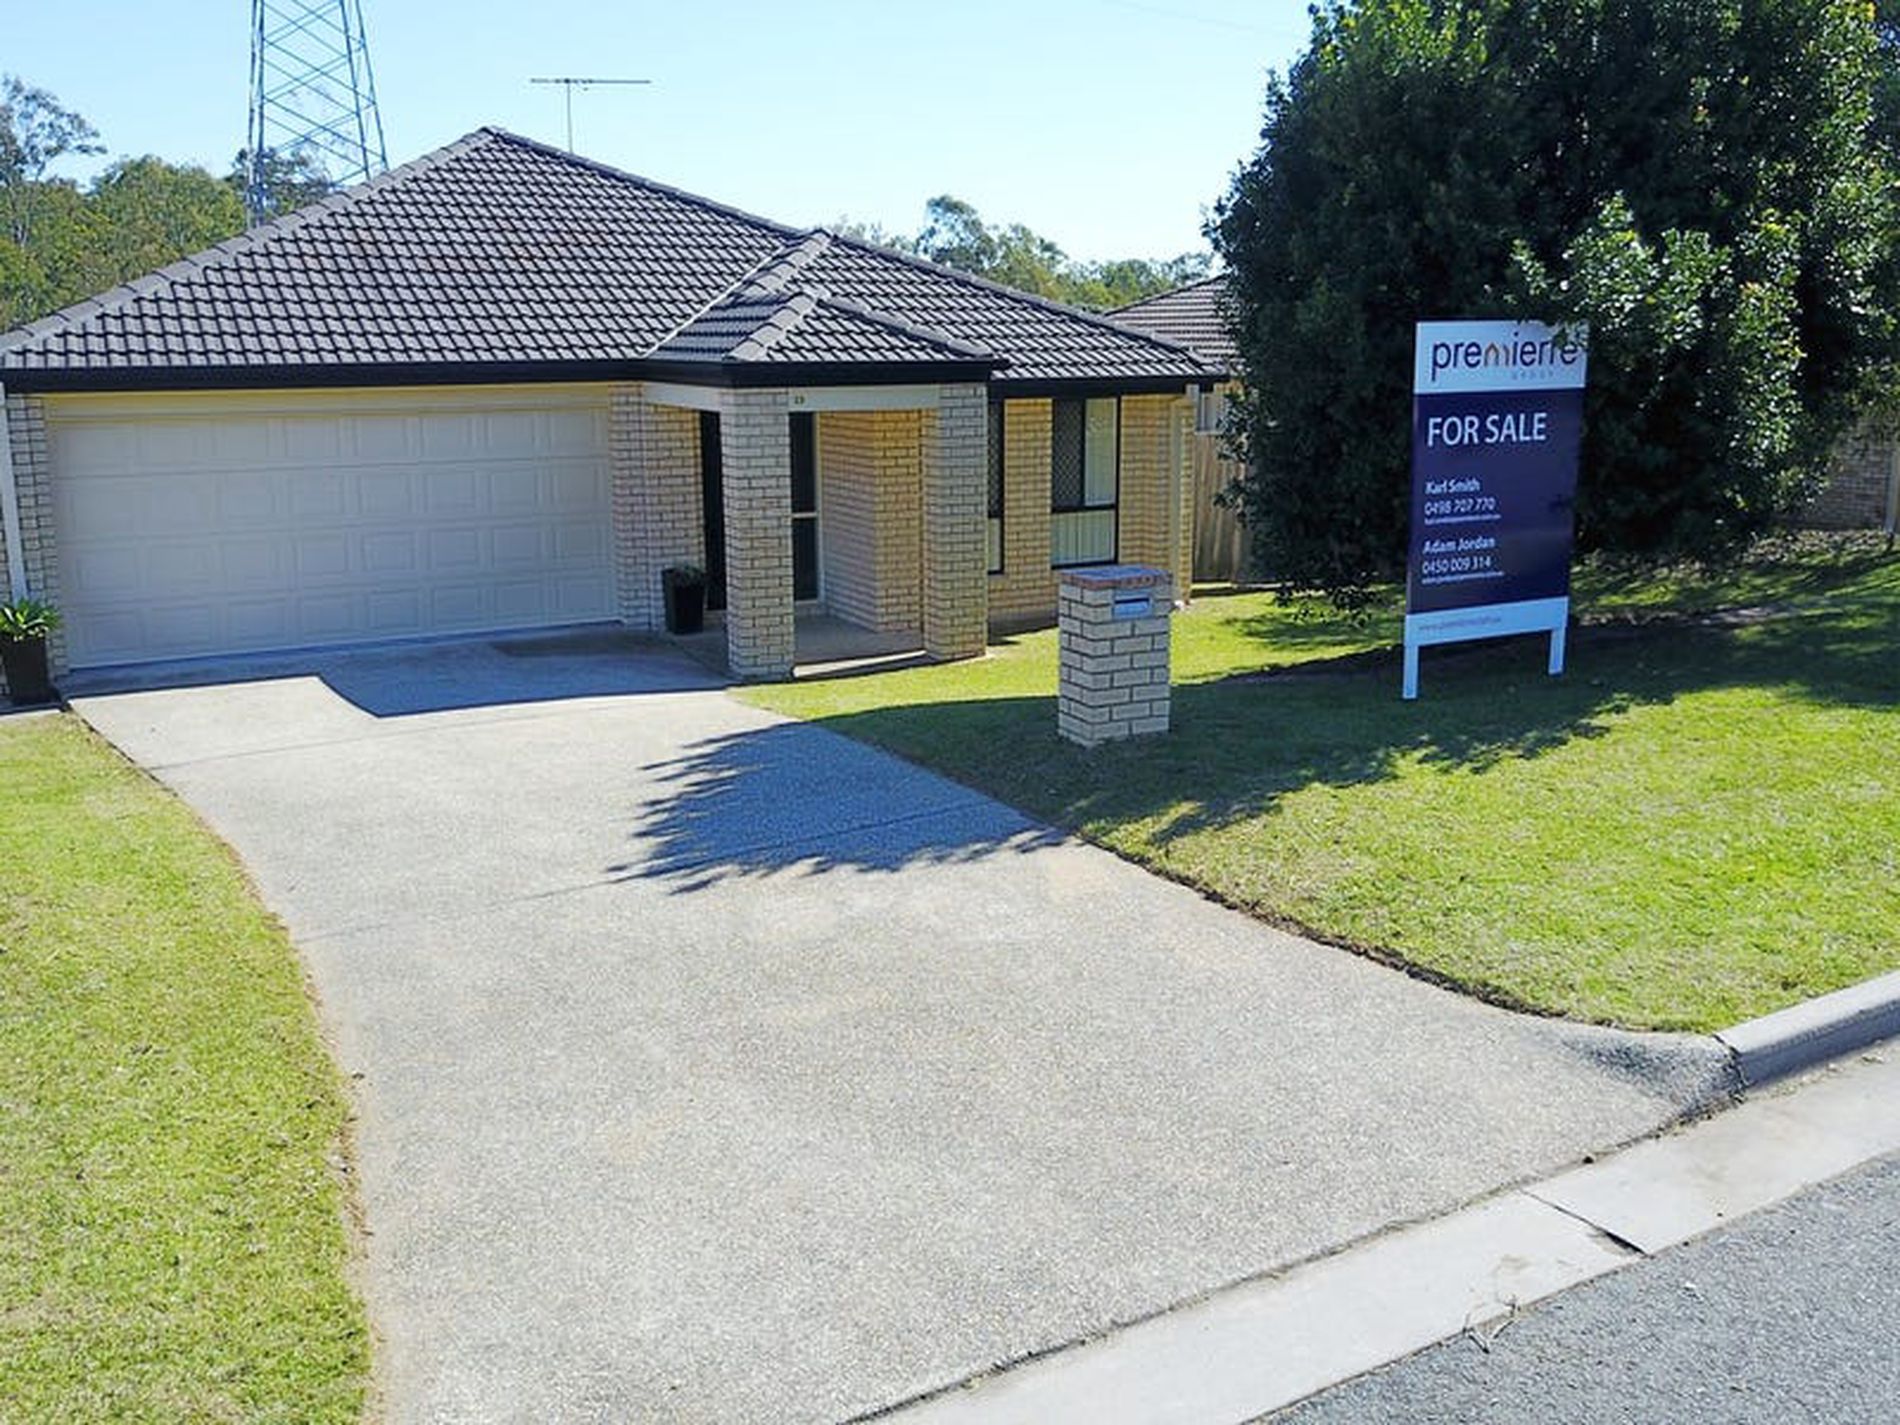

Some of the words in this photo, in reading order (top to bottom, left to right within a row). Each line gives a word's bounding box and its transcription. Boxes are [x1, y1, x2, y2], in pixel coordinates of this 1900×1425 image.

[1427, 417, 1479, 447] FOR
[1485, 413, 1547, 442] SALE
[1449, 478, 1480, 493] Smith
[1422, 540, 1456, 554] Adam
[1458, 536, 1495, 551] Jordan
